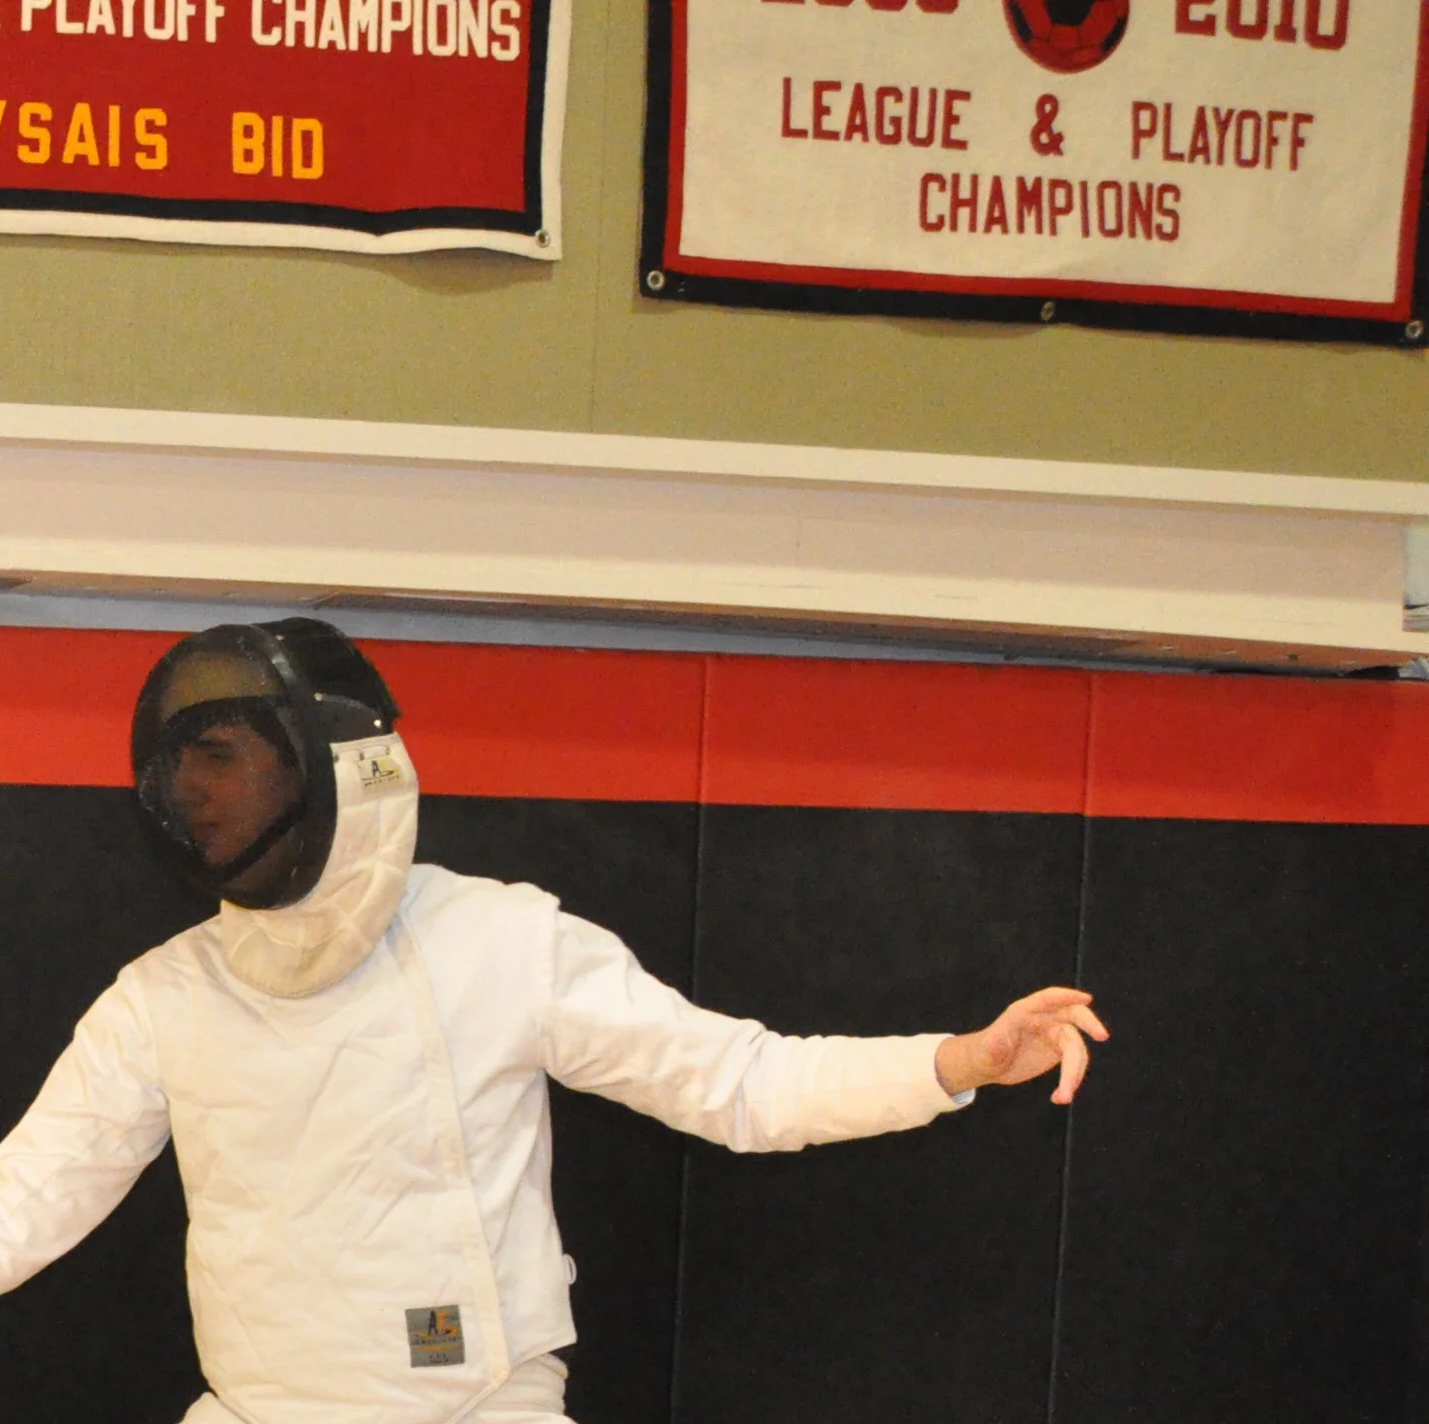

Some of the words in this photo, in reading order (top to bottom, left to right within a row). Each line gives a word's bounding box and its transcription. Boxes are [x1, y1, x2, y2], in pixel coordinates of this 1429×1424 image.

[252, 0, 520, 61] CHAMPIONS
[232, 113, 324, 179] BID
[781, 78, 970, 150] LEAGUE
[1031, 94, 1064, 156] &
[1132, 102, 1314, 170] PLAYOFF
[919, 173, 1181, 241] CHAMPIONS
